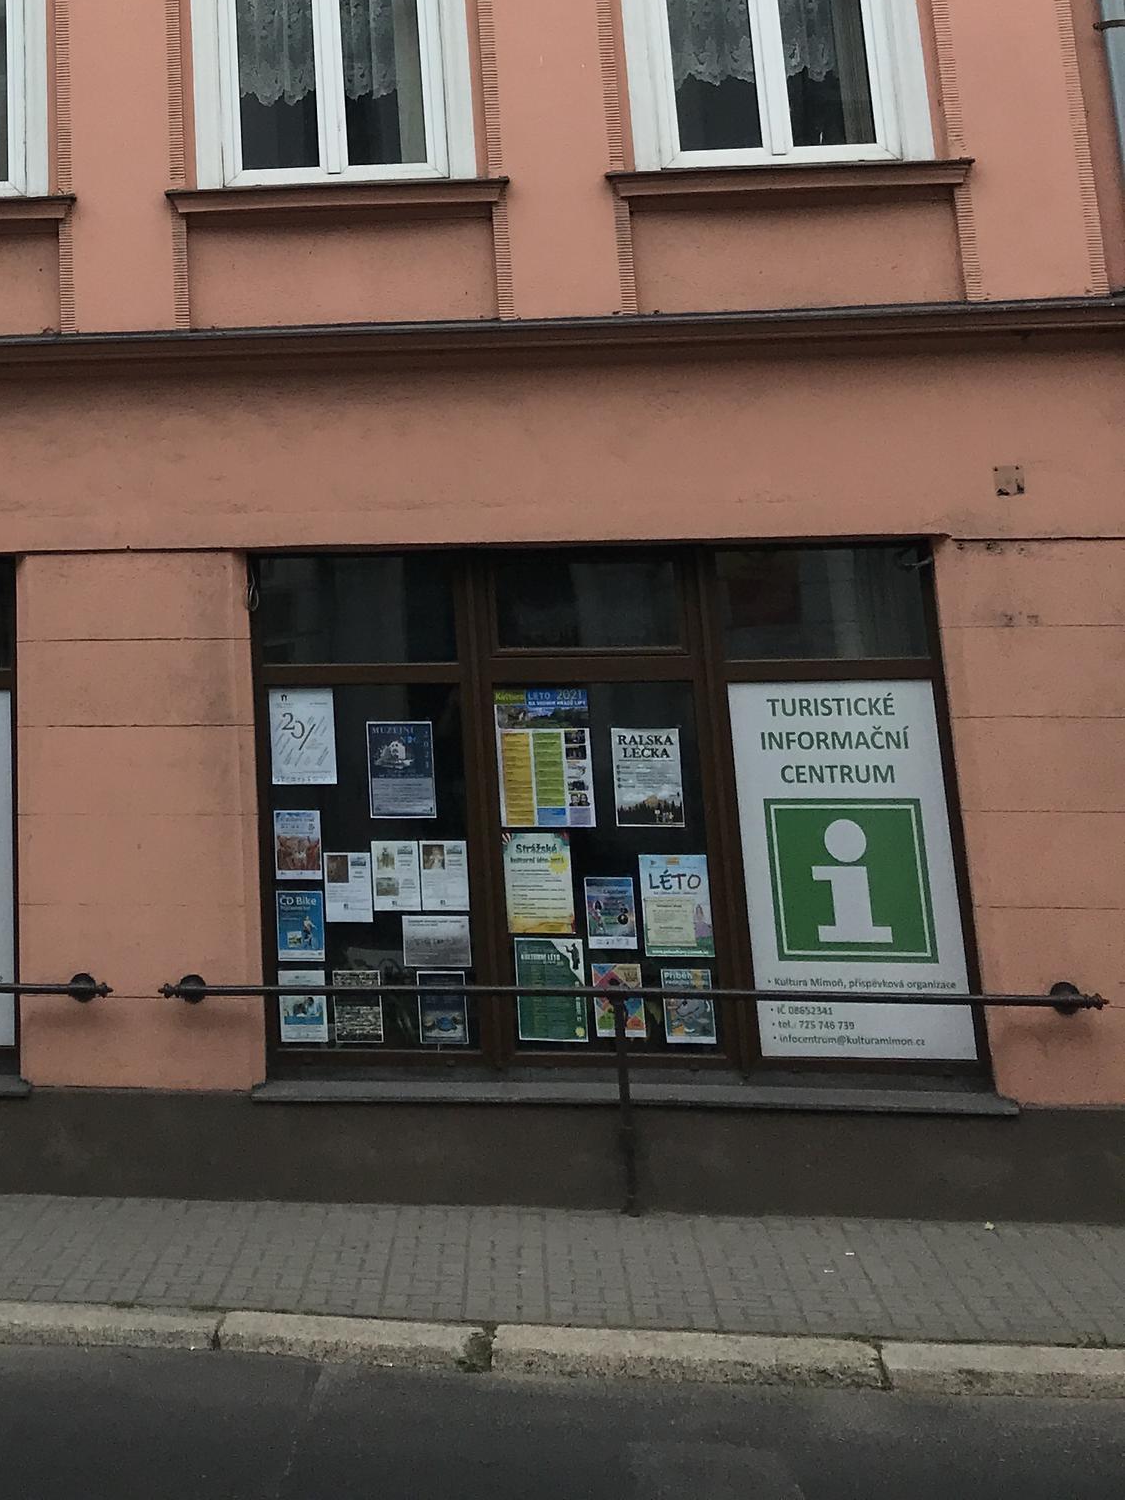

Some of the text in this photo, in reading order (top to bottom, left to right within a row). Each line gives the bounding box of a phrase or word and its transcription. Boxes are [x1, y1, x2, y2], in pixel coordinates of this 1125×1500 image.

[766, 692, 896, 717] TURISTICKÉ
[760, 725, 909, 750] INFORMAČNÍ
[780, 764, 896, 784] CENTRUM
[648, 869, 702, 890] LÉTO
[296, 896, 317, 905] Bike
[775, 977, 808, 987] Kultura
[849, 978, 904, 989] příspěvková
[906, 980, 957, 991] organizace
[777, 1004, 786, 1015] IČ
[799, 1020, 816, 1030] 725
[819, 1021, 836, 1030] 746
[838, 1021, 855, 1031] 739
